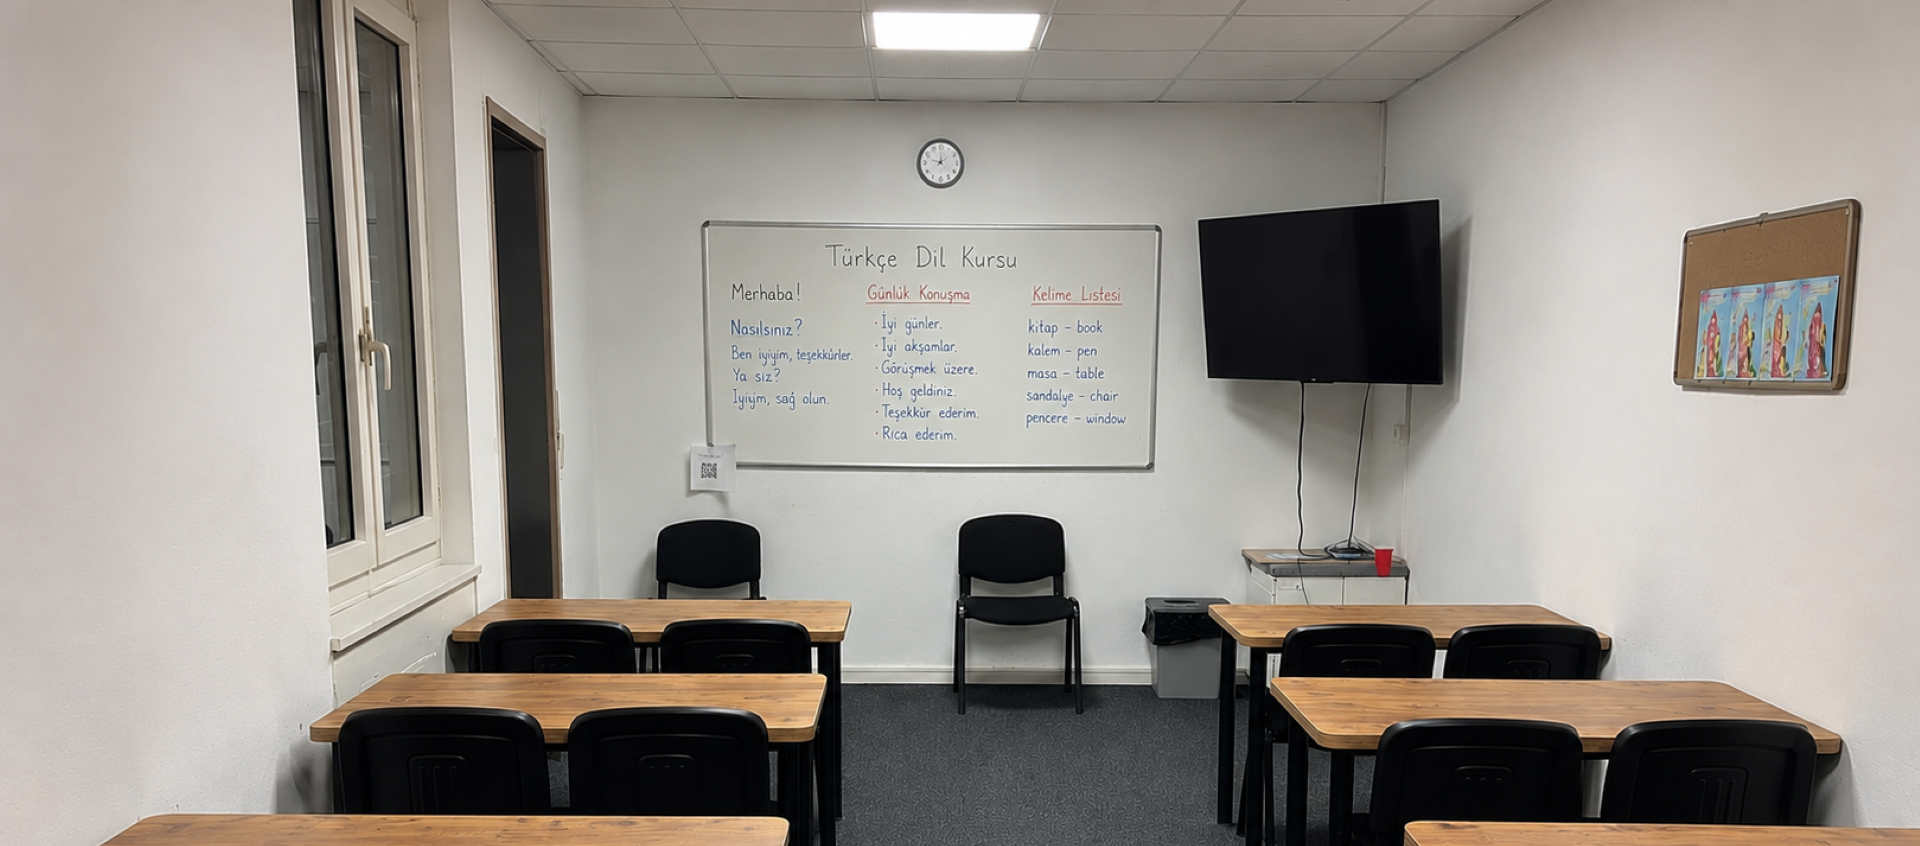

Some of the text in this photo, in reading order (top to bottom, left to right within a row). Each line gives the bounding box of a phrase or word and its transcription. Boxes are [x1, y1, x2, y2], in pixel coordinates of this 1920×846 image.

[825, 243, 1017, 274] Türkçe Dil Kursu
[731, 281, 801, 302] Merhaba!
[919, 284, 971, 304] Konuşma
[1032, 285, 1073, 301] Kelime
[904, 315, 943, 336] günler.
[1028, 318, 1059, 339] kitap
[1077, 319, 1104, 334] book
[731, 344, 753, 360] Ben
[904, 338, 958, 356] akşamlar.
[1027, 342, 1061, 357] kalem
[1077, 346, 1098, 362] pen
[732, 368, 748, 382] Ya
[943, 362, 979, 376] üzere.
[1027, 369, 1059, 379] masa
[1075, 365, 1105, 380] table
[802, 391, 831, 405] olun.
[881, 382, 957, 403] Hoş geldiniz.
[1026, 388, 1074, 408] sandalye
[1090, 388, 1119, 403] chair
[881, 403, 980, 422] Teşekkür ederim.
[1026, 413, 1069, 429] pencere
[1085, 411, 1127, 425] window
[914, 426, 958, 441] ederim.
